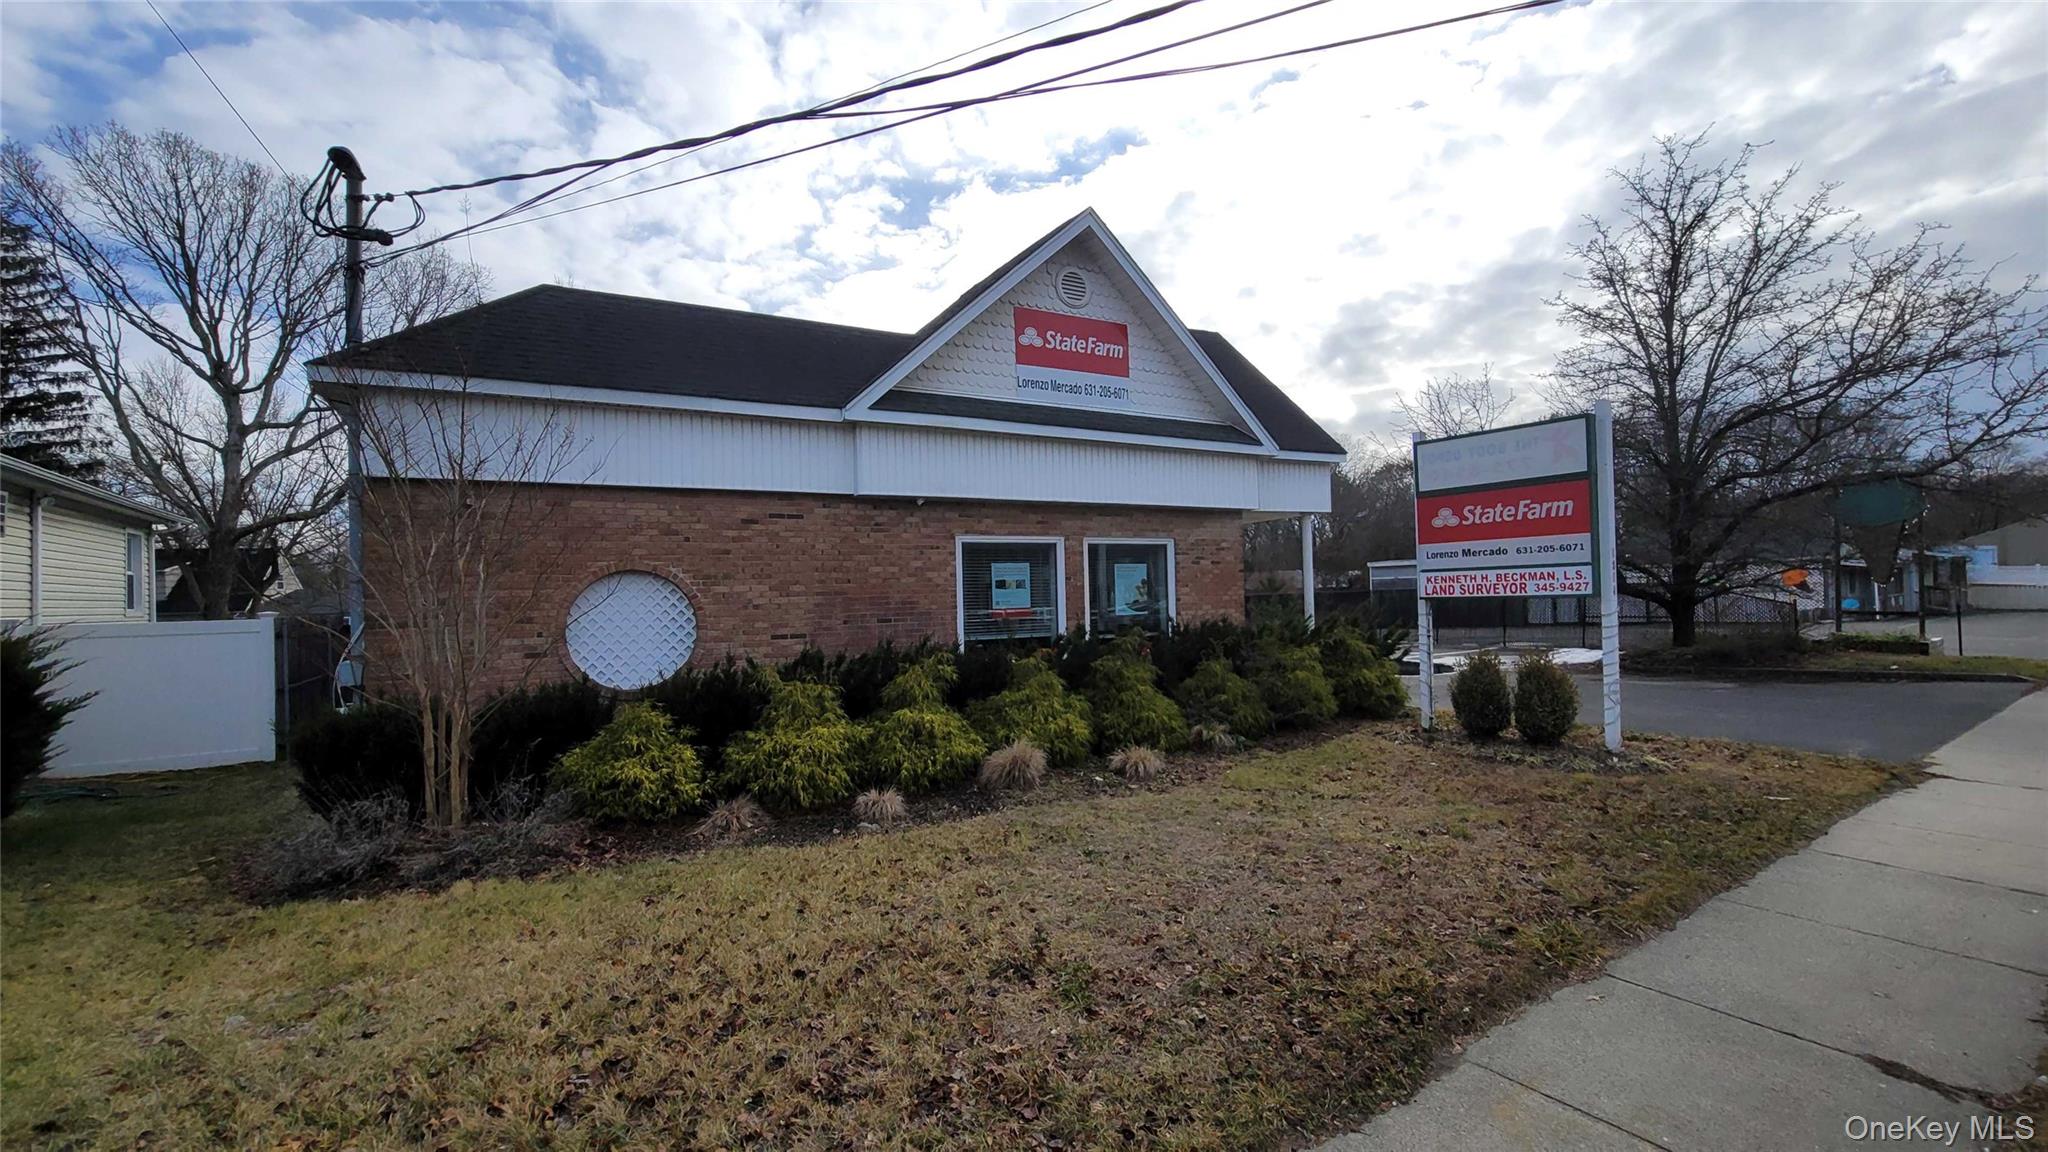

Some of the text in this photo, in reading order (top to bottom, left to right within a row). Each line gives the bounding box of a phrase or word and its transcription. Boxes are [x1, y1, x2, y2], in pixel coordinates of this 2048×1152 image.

[1045, 330, 1124, 359] StateFarm
[1017, 376, 1129, 400] Lorenzo Mercado 631-205-6071
[1462, 499, 1574, 526] StateFarm
[1426, 543, 1585, 560] Lorenzo Mercado 631-205-6071
[1426, 570, 1587, 584] KENNETH H. BECKMAN, L.S.
[1425, 581, 1590, 596] LAND SURVEYOR 345-9427
